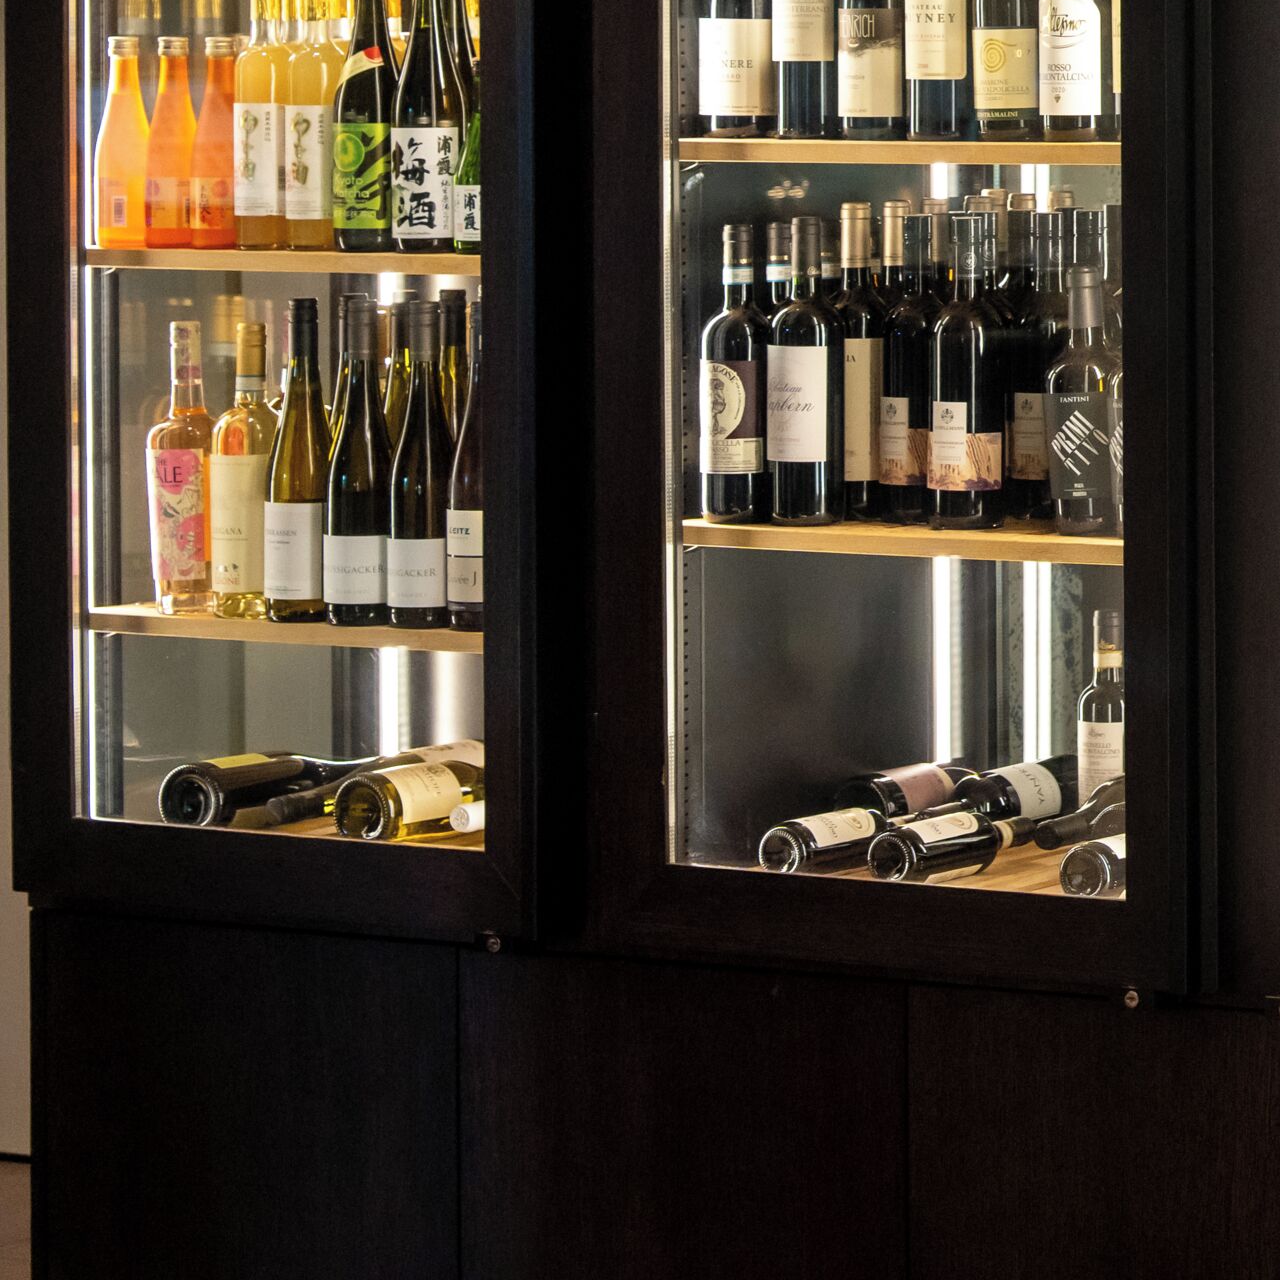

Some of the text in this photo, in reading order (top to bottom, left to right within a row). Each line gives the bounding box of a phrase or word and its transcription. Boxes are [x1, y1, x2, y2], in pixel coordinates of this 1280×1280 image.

[1047, 63, 1072, 72] ROSSO
[436, 134, 456, 177] 浦霞
[391, 136, 437, 230] 梅酒
[1059, 395, 1090, 404] FANTINI
